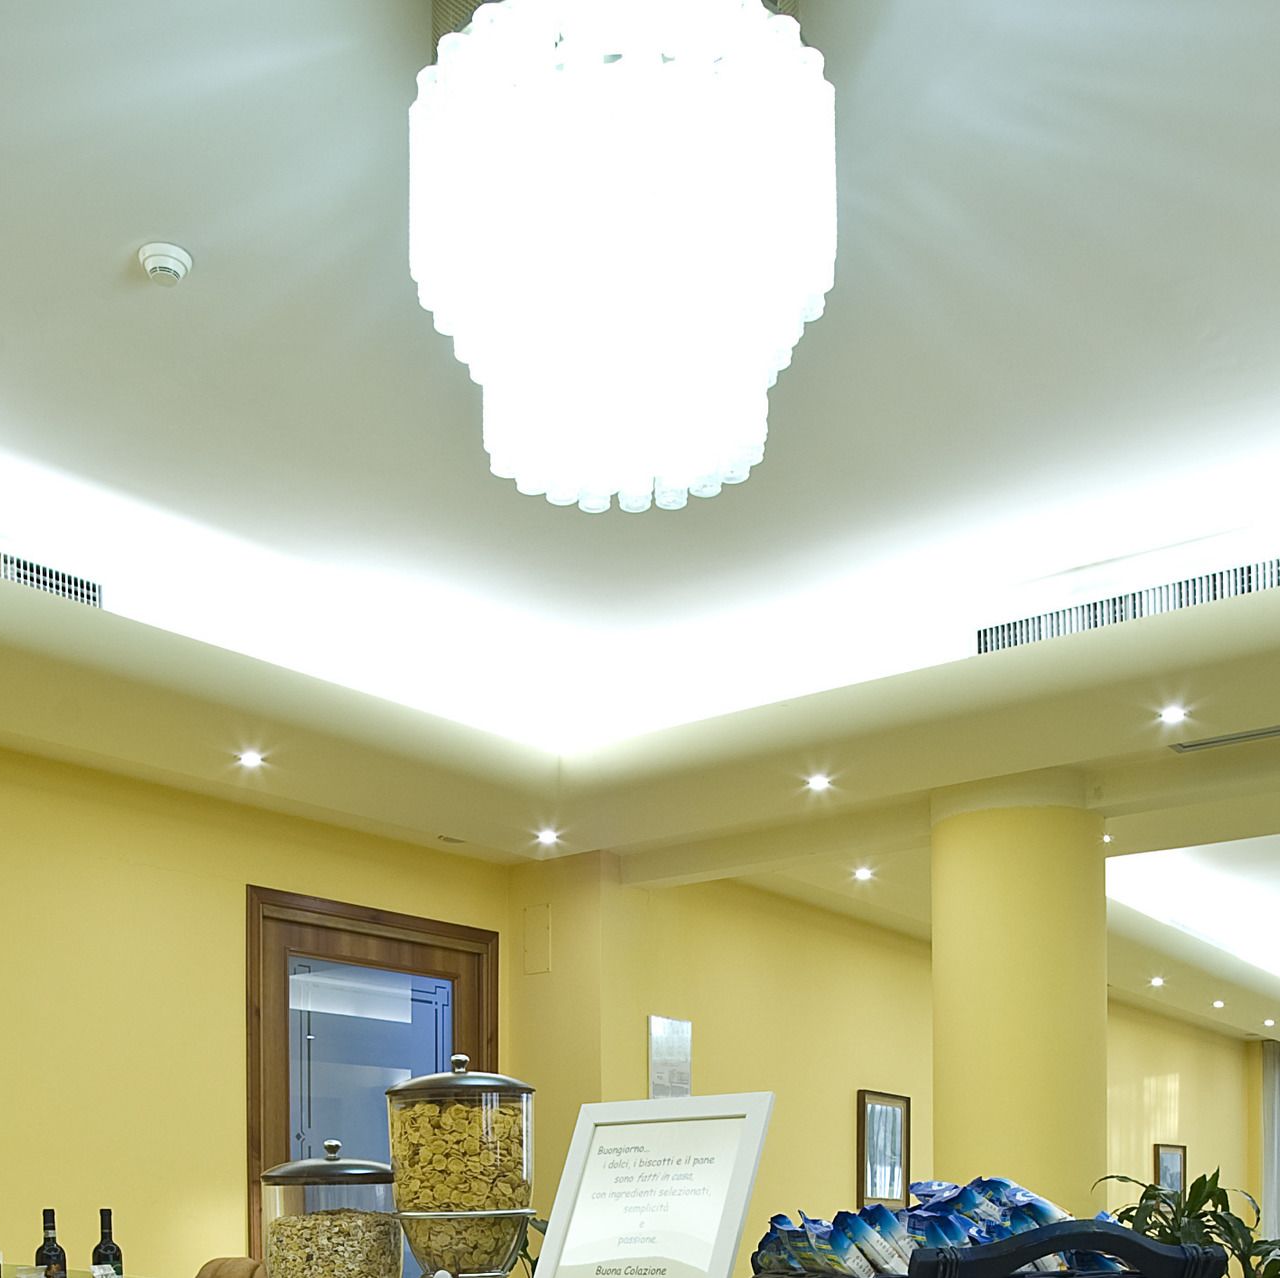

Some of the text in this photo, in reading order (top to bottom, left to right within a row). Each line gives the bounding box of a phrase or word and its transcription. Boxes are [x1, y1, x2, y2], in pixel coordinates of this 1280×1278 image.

[608, 1159, 631, 1169] dolci,
[639, 1157, 674, 1168] biscotti
[684, 1156, 692, 1165] il
[692, 1156, 715, 1167] pane
[613, 1175, 634, 1184] sono
[636, 1172, 658, 1183] fatti
[660, 1172, 670, 1181] in
[591, 1191, 607, 1200] con
[608, 1187, 657, 1201] ingredienti
[595, 1265, 668, 1276] Buona Colazione
